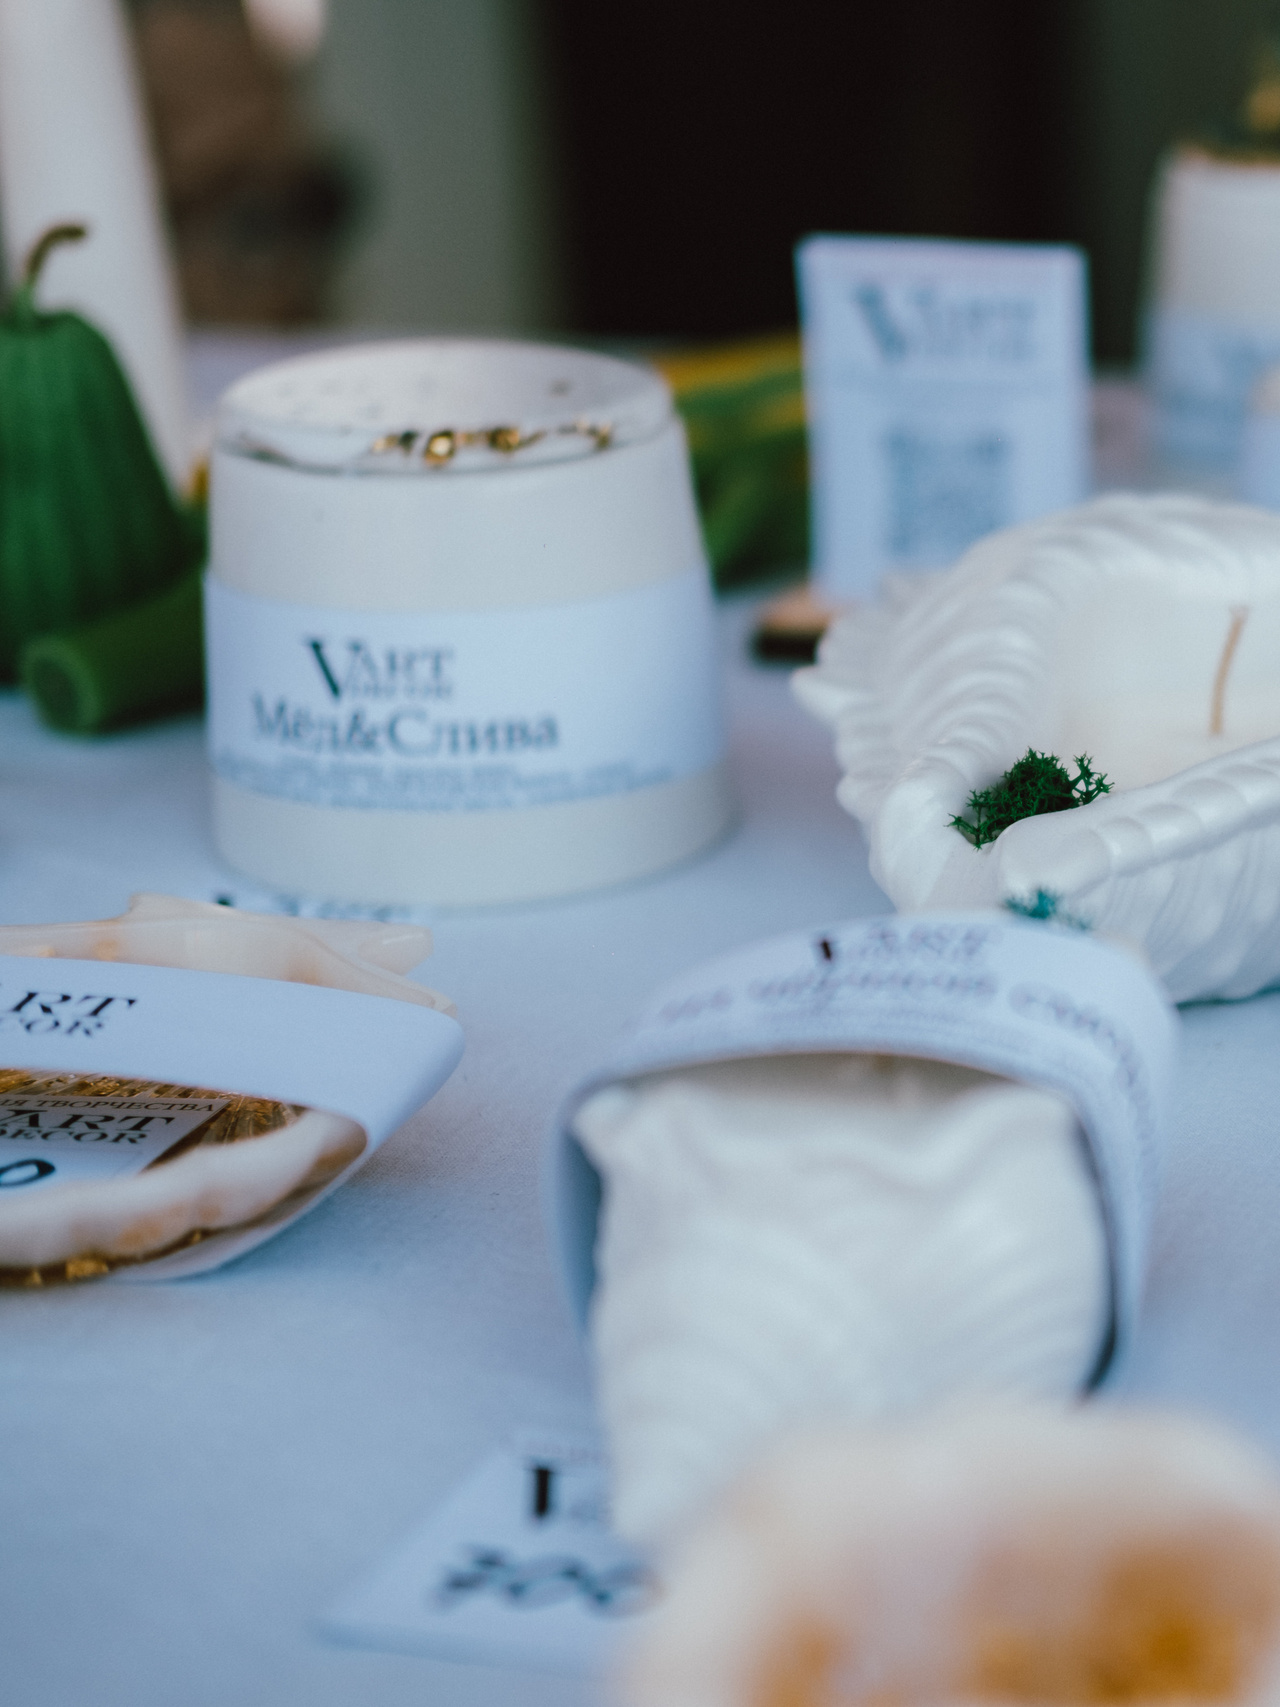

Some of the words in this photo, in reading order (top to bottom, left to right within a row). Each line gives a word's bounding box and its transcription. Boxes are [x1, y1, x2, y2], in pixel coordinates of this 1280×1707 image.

[306, 634, 456, 700] VART
[0, 988, 138, 1018] RT
[36, 1099, 214, 1113] ТВОРЧЕСТВА
